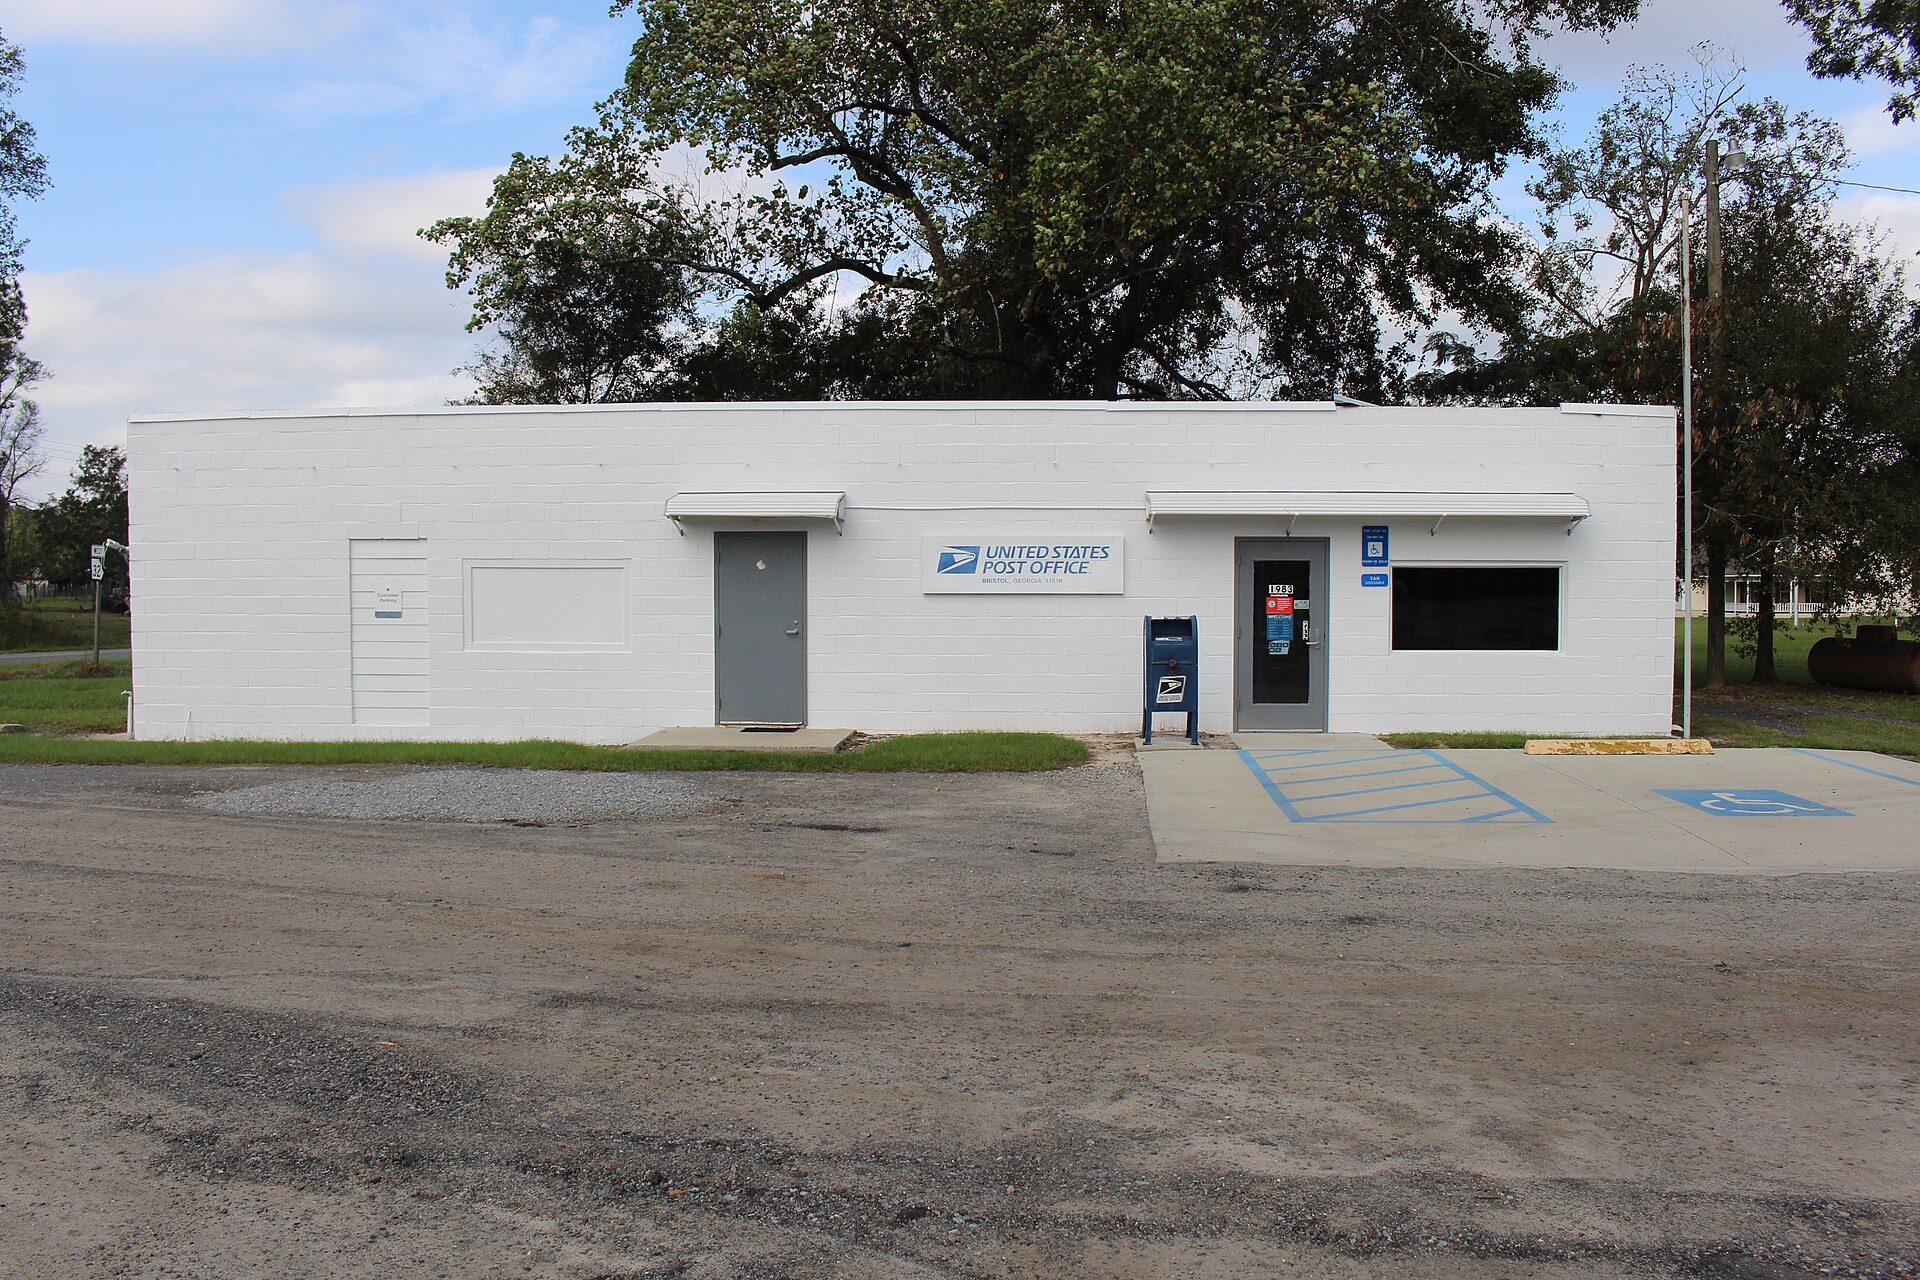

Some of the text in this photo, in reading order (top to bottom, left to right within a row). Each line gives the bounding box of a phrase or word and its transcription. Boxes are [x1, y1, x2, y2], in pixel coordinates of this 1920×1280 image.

[986, 545, 1110, 559] UNITED STATES
[92, 564, 101, 578] 32
[983, 561, 1090, 574] POST OFFICE
[1270, 585, 1293, 593] 1983
